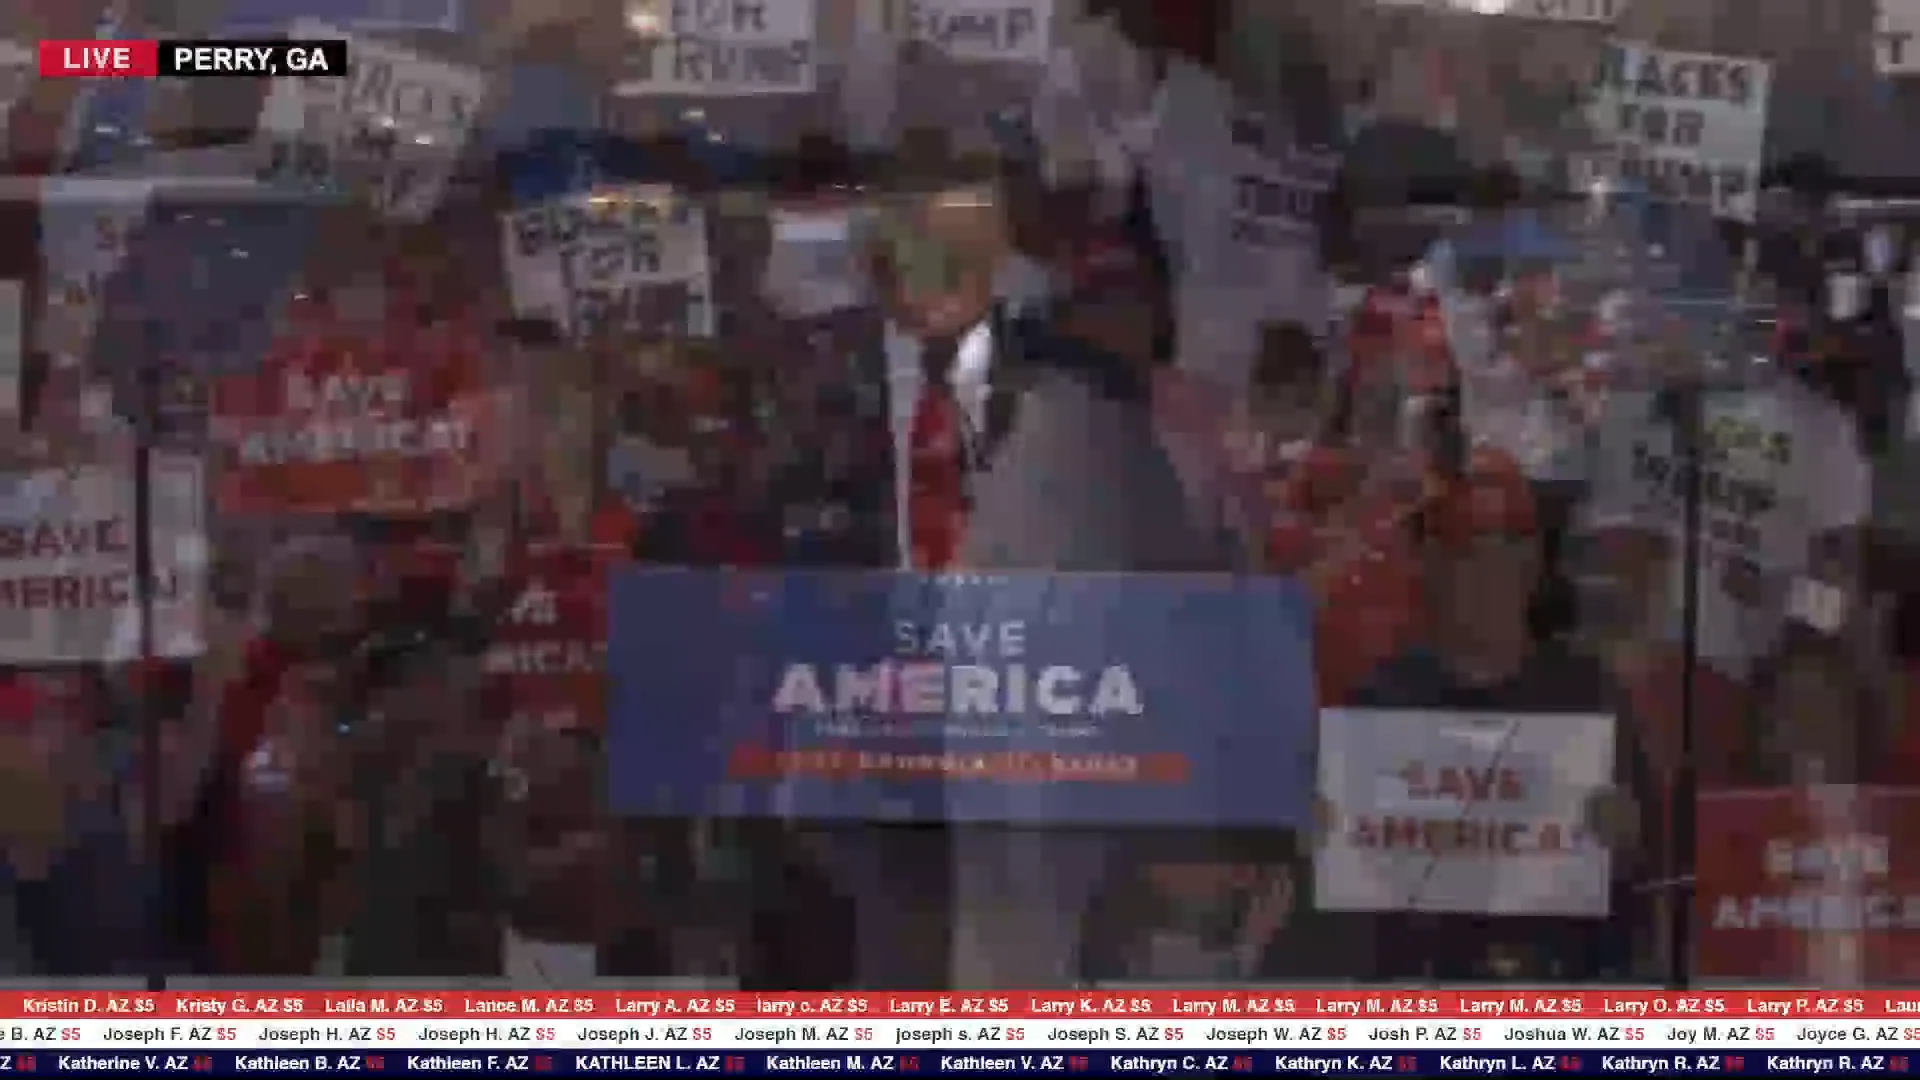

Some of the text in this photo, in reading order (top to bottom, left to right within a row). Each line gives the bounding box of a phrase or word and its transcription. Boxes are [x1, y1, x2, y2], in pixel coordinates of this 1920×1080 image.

[0, 519, 128, 558] SAVE
[895, 620, 1027, 657] SAVE
[772, 663, 1144, 716] AMERICA
